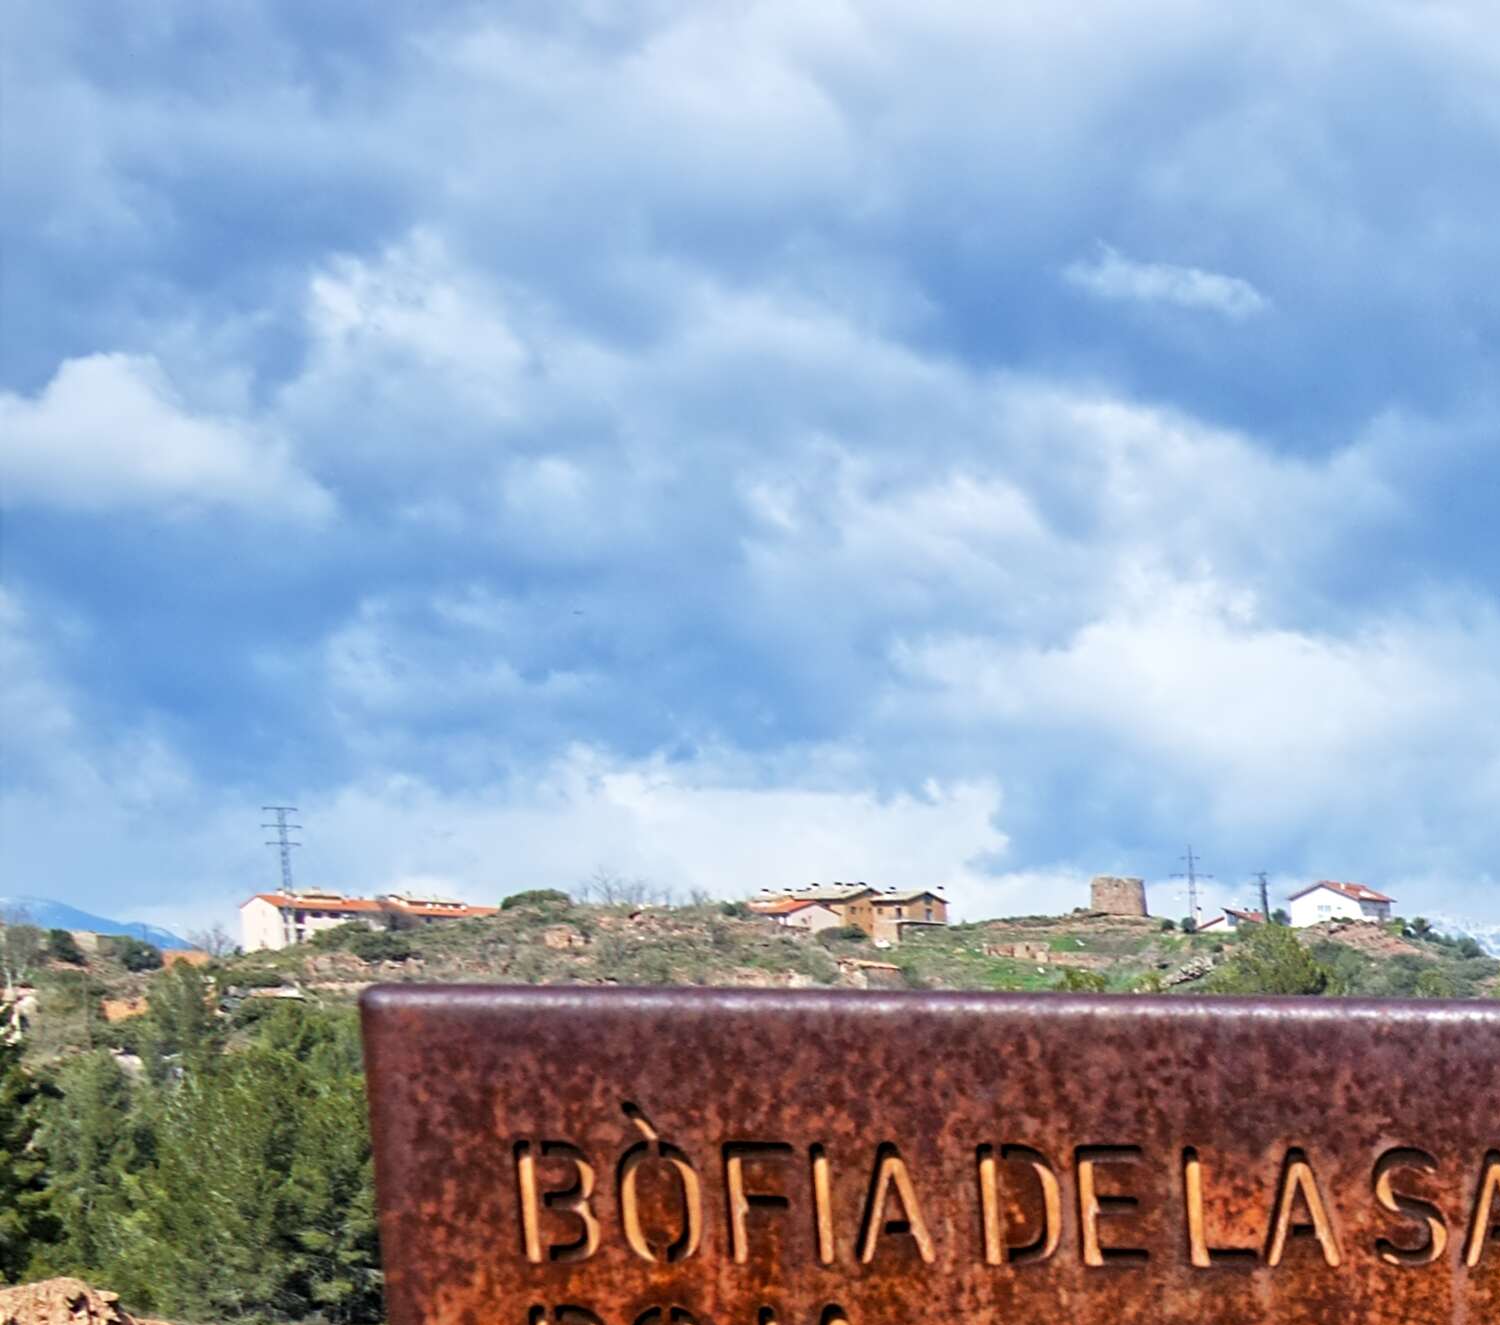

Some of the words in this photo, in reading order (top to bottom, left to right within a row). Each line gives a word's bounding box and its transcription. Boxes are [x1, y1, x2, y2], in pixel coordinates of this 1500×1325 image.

[511, 1100, 938, 1265] BÒFIA
[975, 1142, 1150, 1267] DE
[1181, 1144, 1343, 1268] LA
